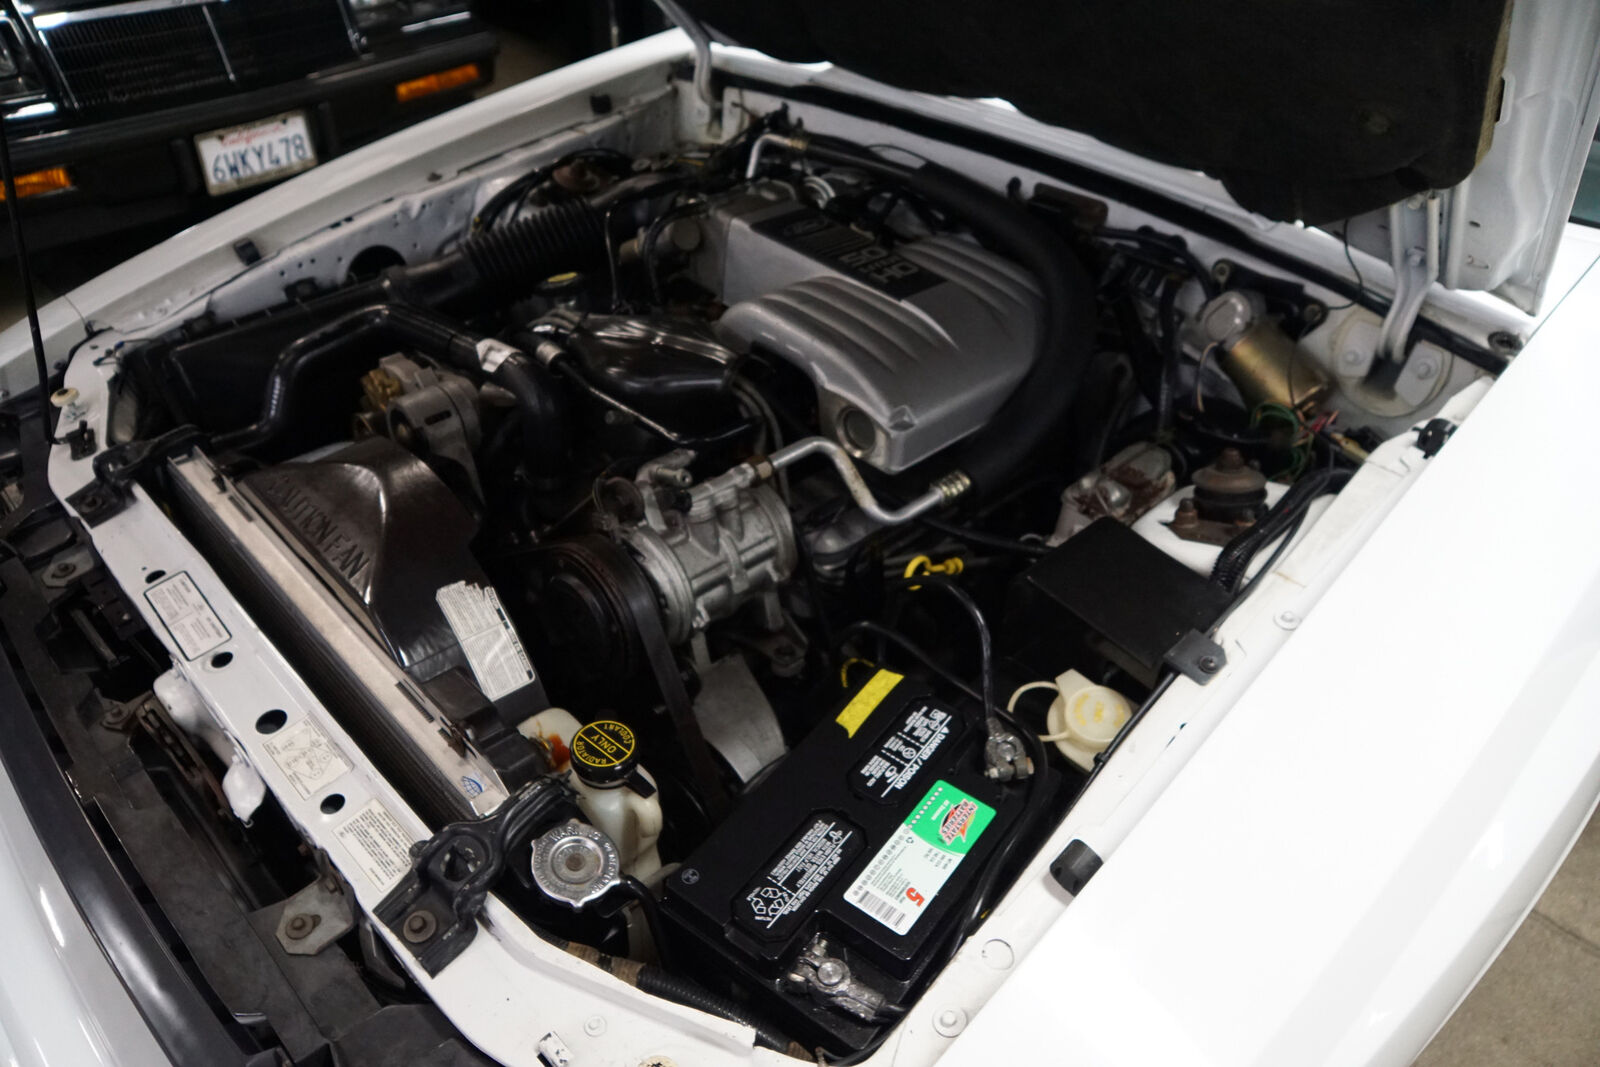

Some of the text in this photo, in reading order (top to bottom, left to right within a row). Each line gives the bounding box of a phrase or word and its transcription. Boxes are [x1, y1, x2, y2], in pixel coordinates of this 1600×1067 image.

[212, 133, 307, 183] 6WKY478
[323, 533, 370, 580] FAN
[591, 734, 617, 753] ONLY
[603, 724, 632, 744] COOLANT
[919, 733, 946, 760] DANGER
[576, 741, 607, 764] RADIATOR
[894, 763, 920, 790] POISON
[941, 800, 969, 836] BATTERIES
[947, 801, 976, 842] INTERSTATE
[905, 887, 925, 907] 5
